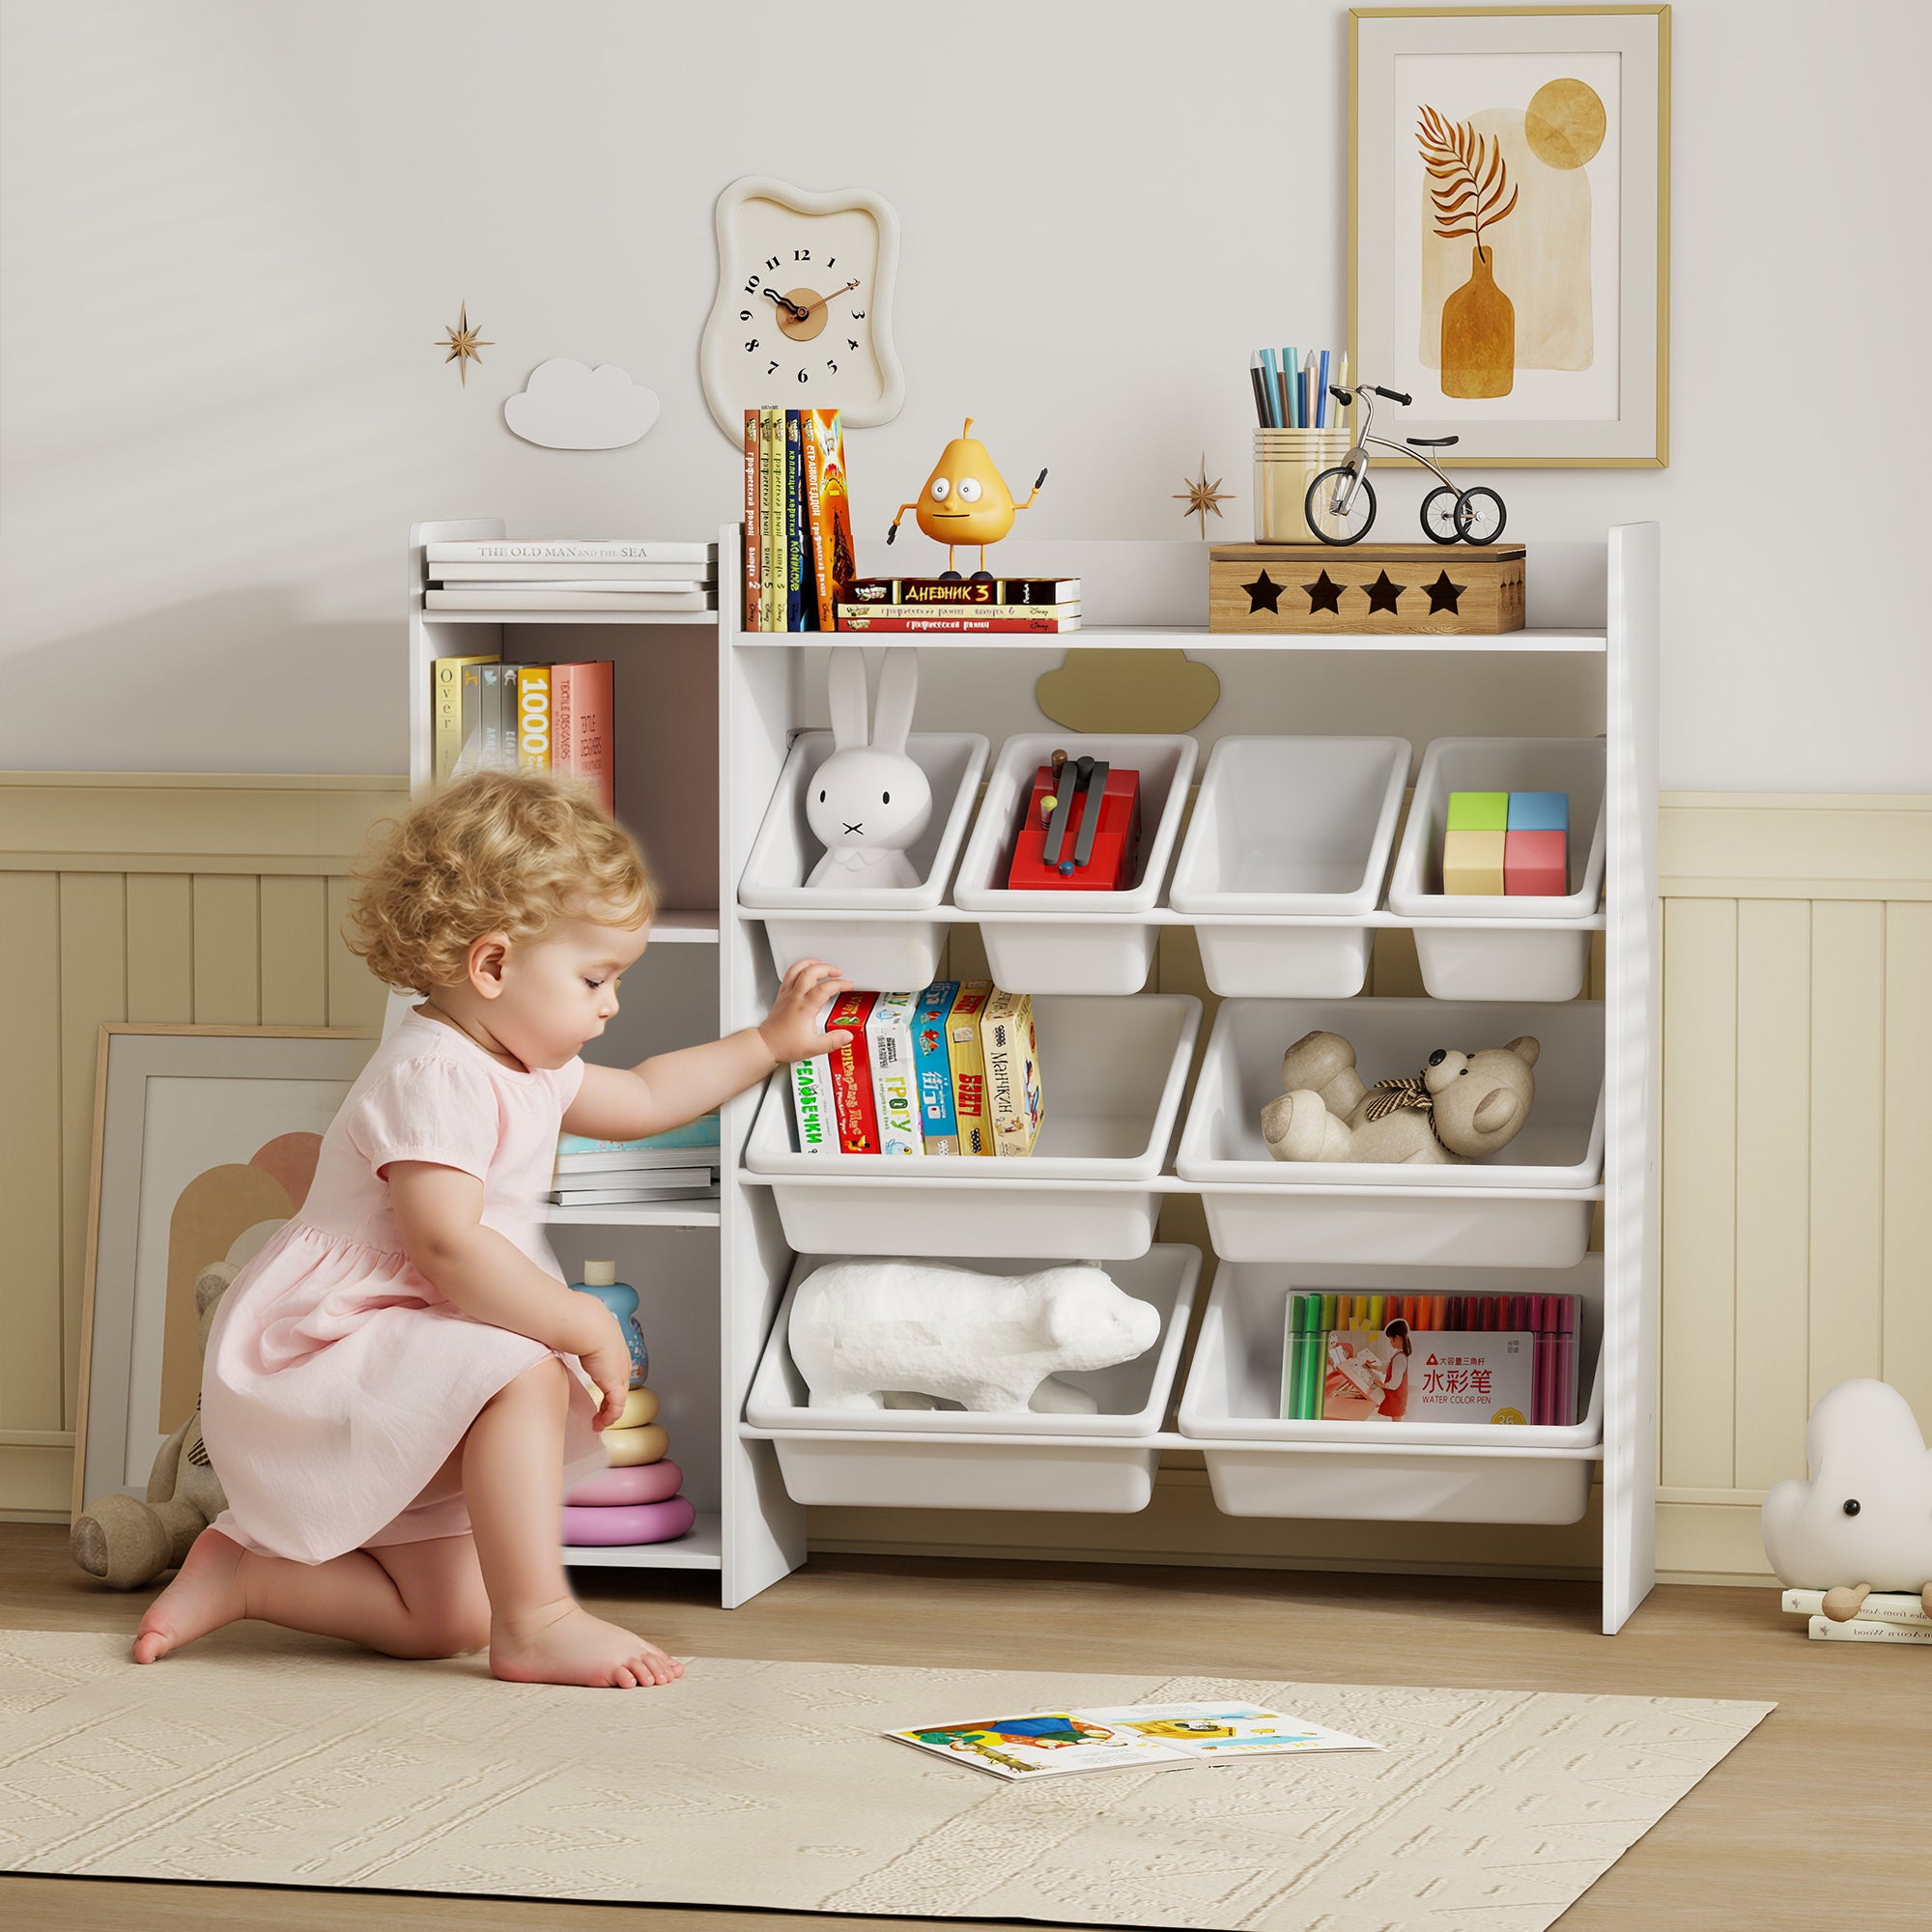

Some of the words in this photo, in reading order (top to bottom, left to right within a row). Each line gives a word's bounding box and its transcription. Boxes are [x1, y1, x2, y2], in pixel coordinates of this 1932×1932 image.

[793, 249, 810, 261] 12
[765, 256, 781, 270] 11
[827, 257, 836, 269] 1
[744, 275, 760, 296] 10
[740, 310, 753, 322] 9
[851, 309, 866, 320] 3
[745, 338, 760, 353] 8
[847, 338, 859, 351] 4
[767, 360, 780, 375] 7
[826, 359, 838, 375] 5
[797, 367, 809, 383] 6
[806, 445, 821, 517] СТРАННОГЕДДОН
[477, 547, 507, 557] THE
[510, 547, 541, 557] OLD
[544, 547, 578, 557] MAN
[620, 547, 647, 557] SEA
[905, 585, 973, 601] ДНЕВНИК
[976, 584, 989, 602] 3
[560, 680, 570, 711] TEXTILE
[522, 678, 549, 754] 1000
[991, 1052, 1013, 1114] Манчкин
[1439, 1357, 1486, 1366] 大容量三角杆
[1422, 1369, 1492, 1394] 水彩笔
[1449, 1396, 1475, 1405] COLOR
[1476, 1396, 1492, 1405] PEN
